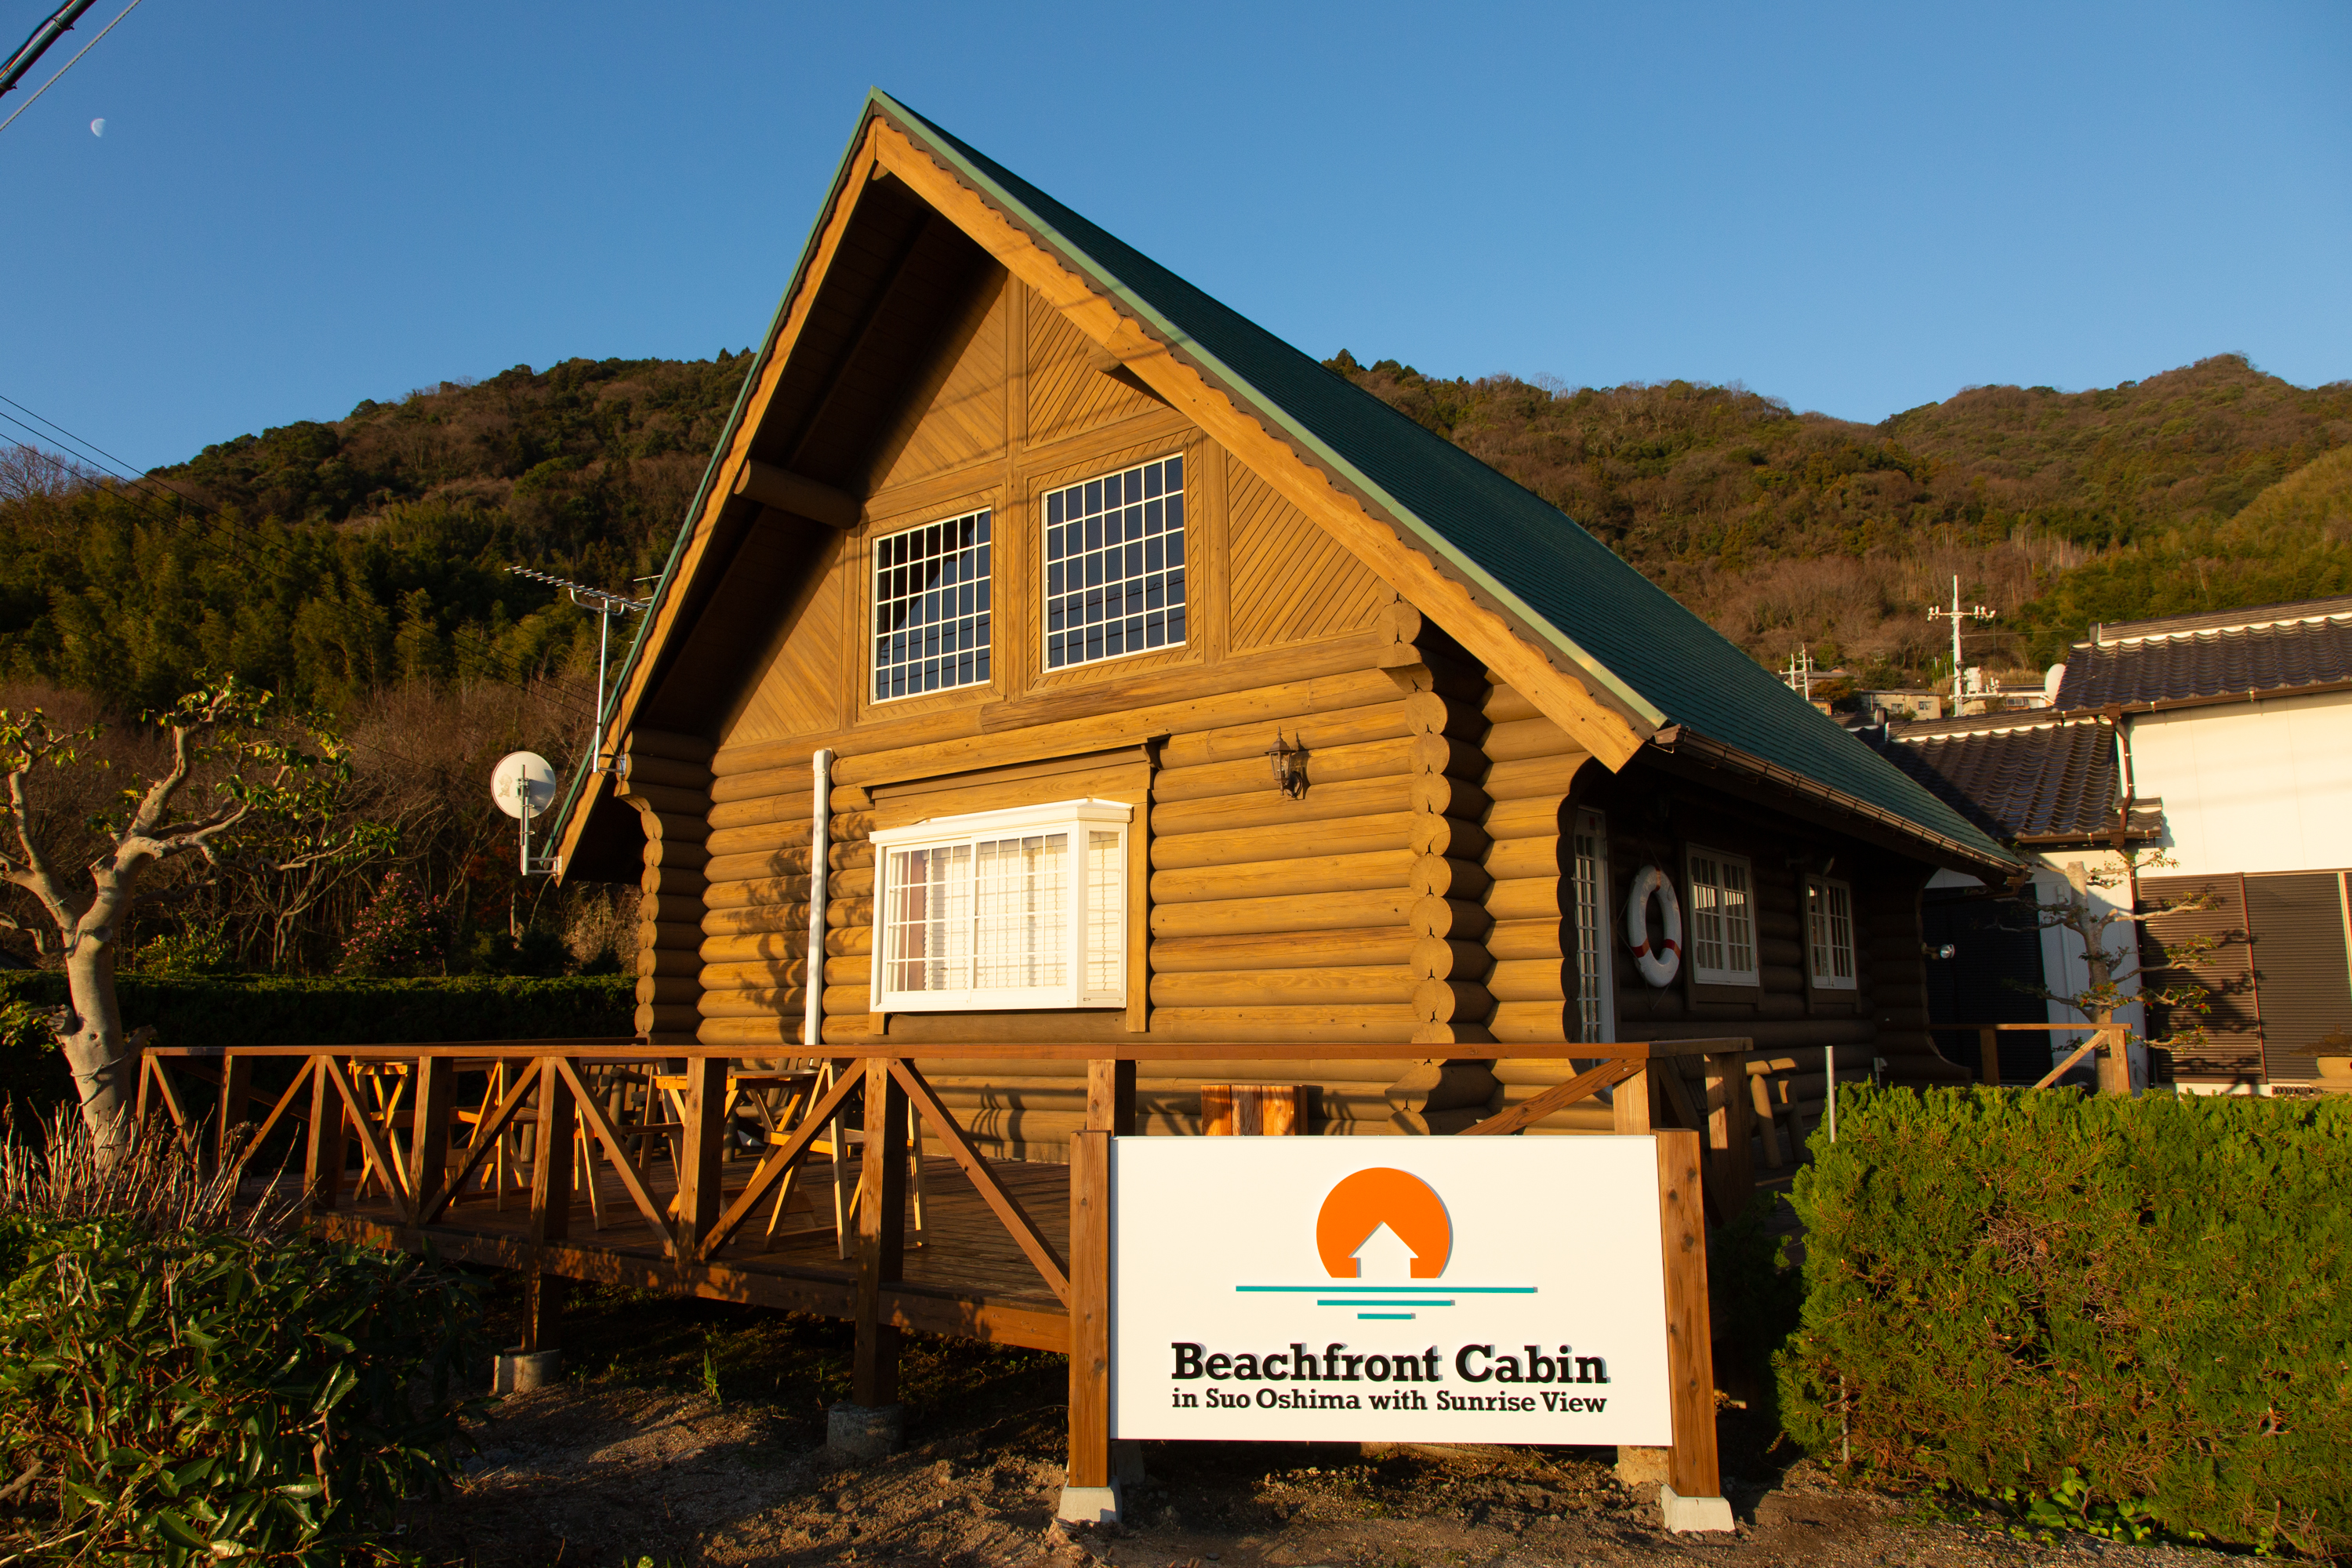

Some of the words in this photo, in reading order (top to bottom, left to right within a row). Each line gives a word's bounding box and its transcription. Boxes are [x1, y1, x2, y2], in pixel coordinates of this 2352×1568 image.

[1171, 1342, 1439, 1382] Beachfront
[1455, 1344, 1608, 1384] Cabin
[1172, 1387, 1198, 1408] in
[1206, 1388, 1250, 1409] Suo
[1256, 1388, 1361, 1410] Oshima
[1368, 1389, 1428, 1410] with
[1436, 1390, 1536, 1412] Sunrise
[1540, 1392, 1607, 1413] View
